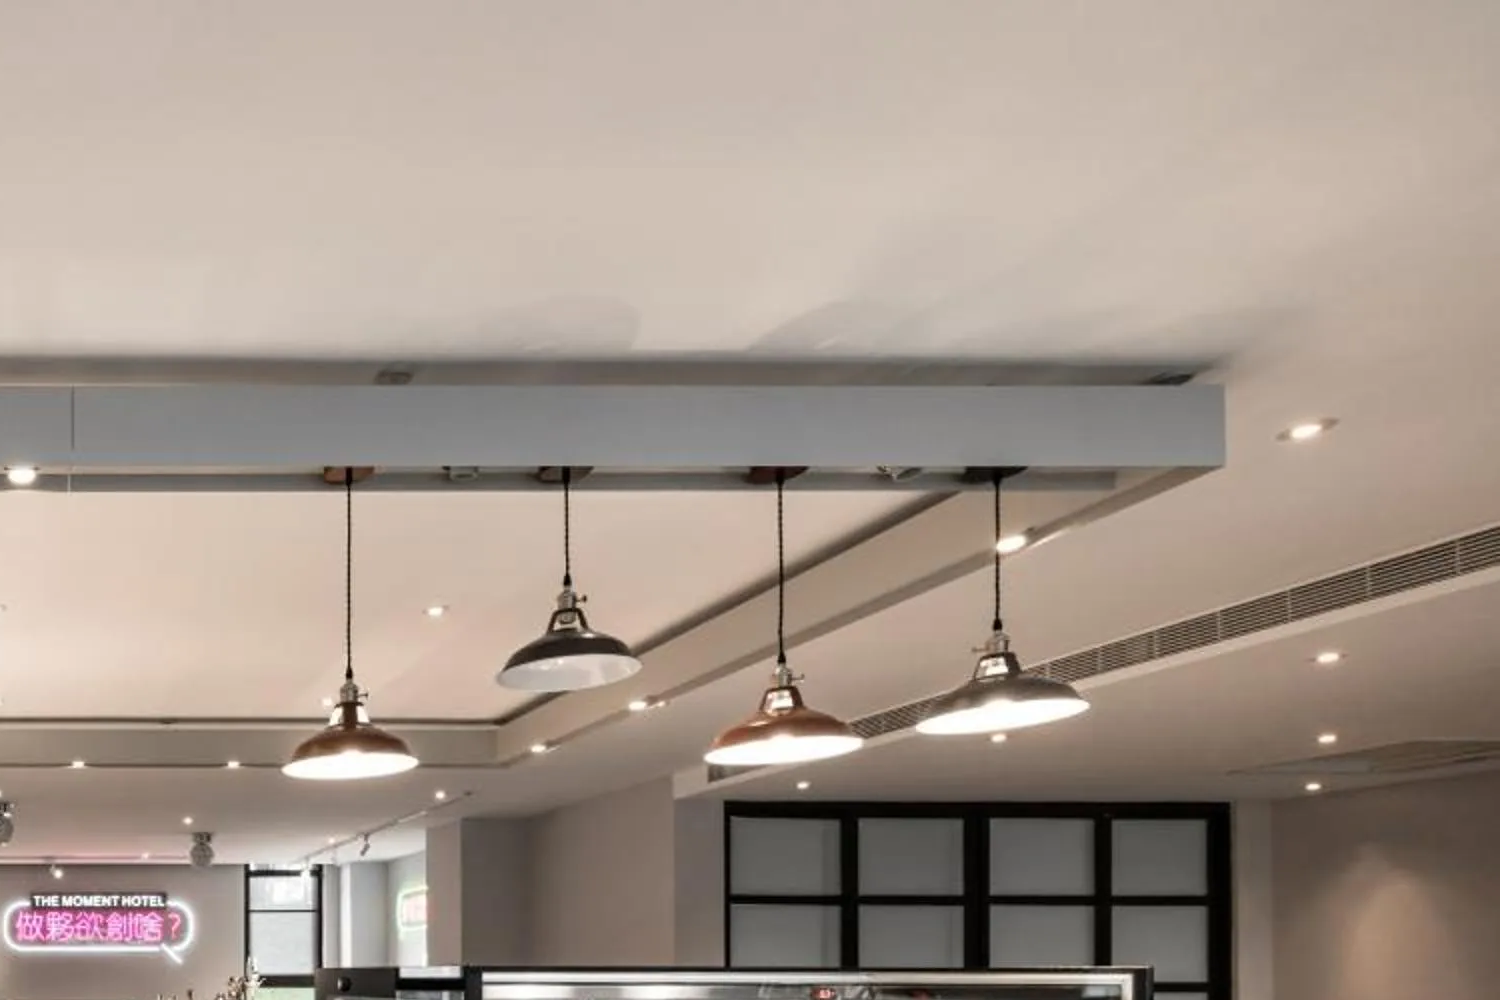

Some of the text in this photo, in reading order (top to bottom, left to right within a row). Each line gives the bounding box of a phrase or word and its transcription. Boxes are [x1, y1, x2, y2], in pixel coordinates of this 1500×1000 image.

[33, 895, 165, 907] THE MOMENT HOTEL
